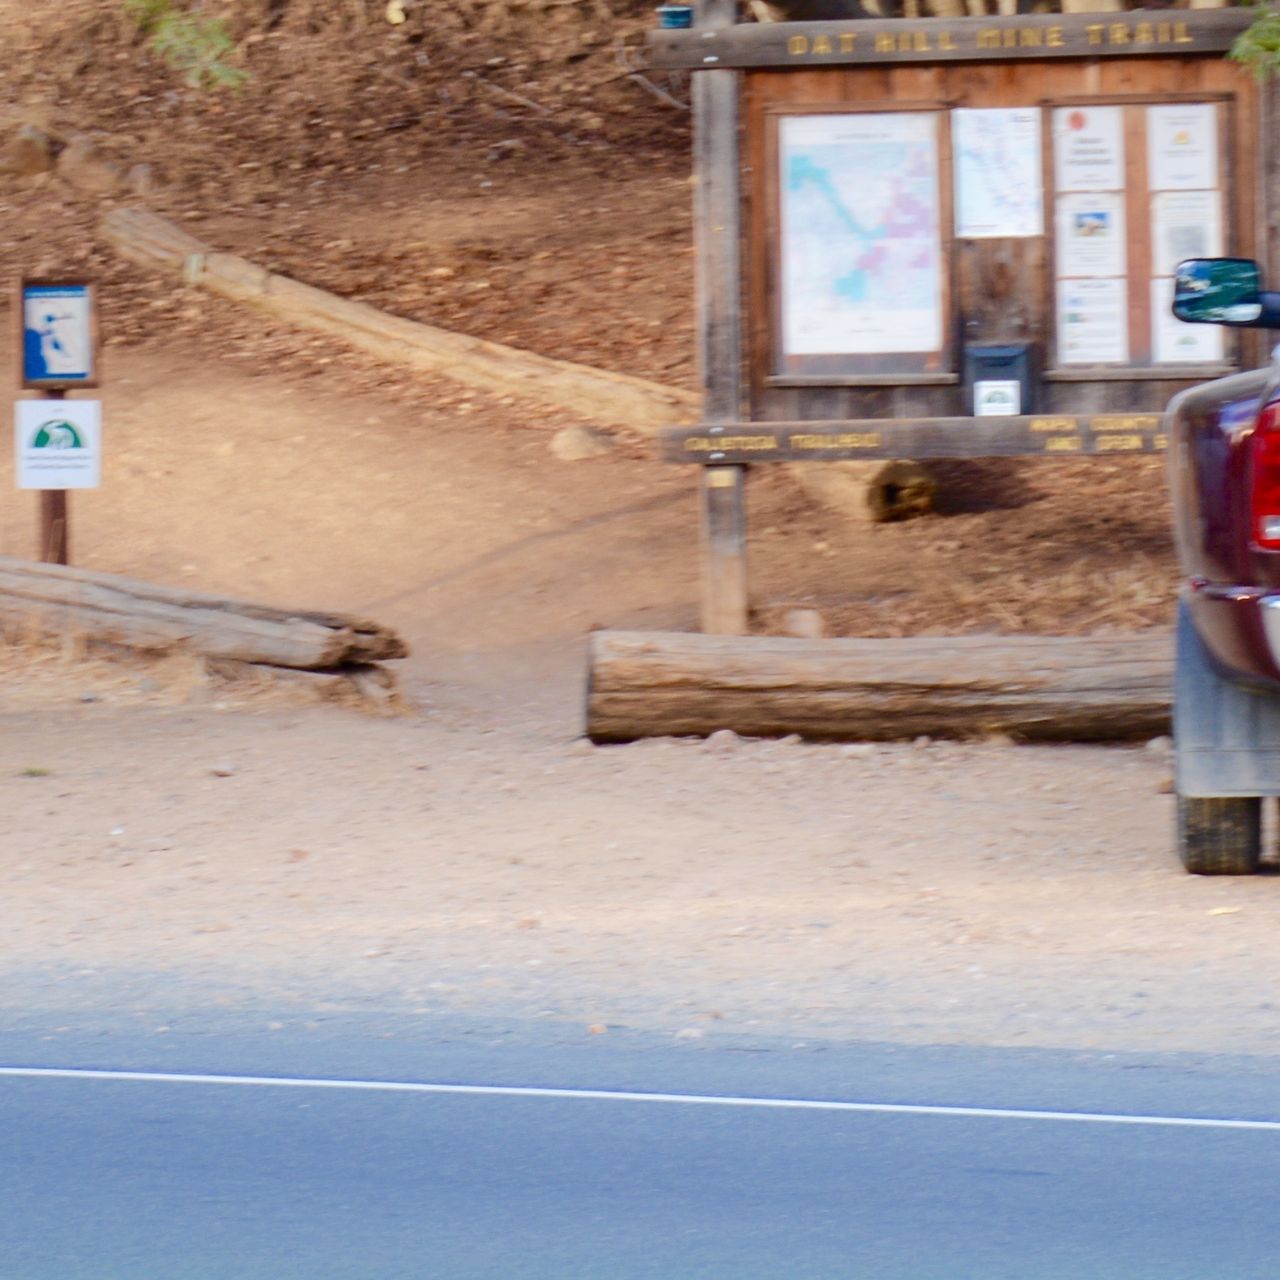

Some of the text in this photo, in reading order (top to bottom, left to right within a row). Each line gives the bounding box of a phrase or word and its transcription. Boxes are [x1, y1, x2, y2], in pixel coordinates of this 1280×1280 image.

[787, 21, 1195, 56] OAT HILL MINE TRAIL
[1089, 416, 1160, 431] COUNTY
